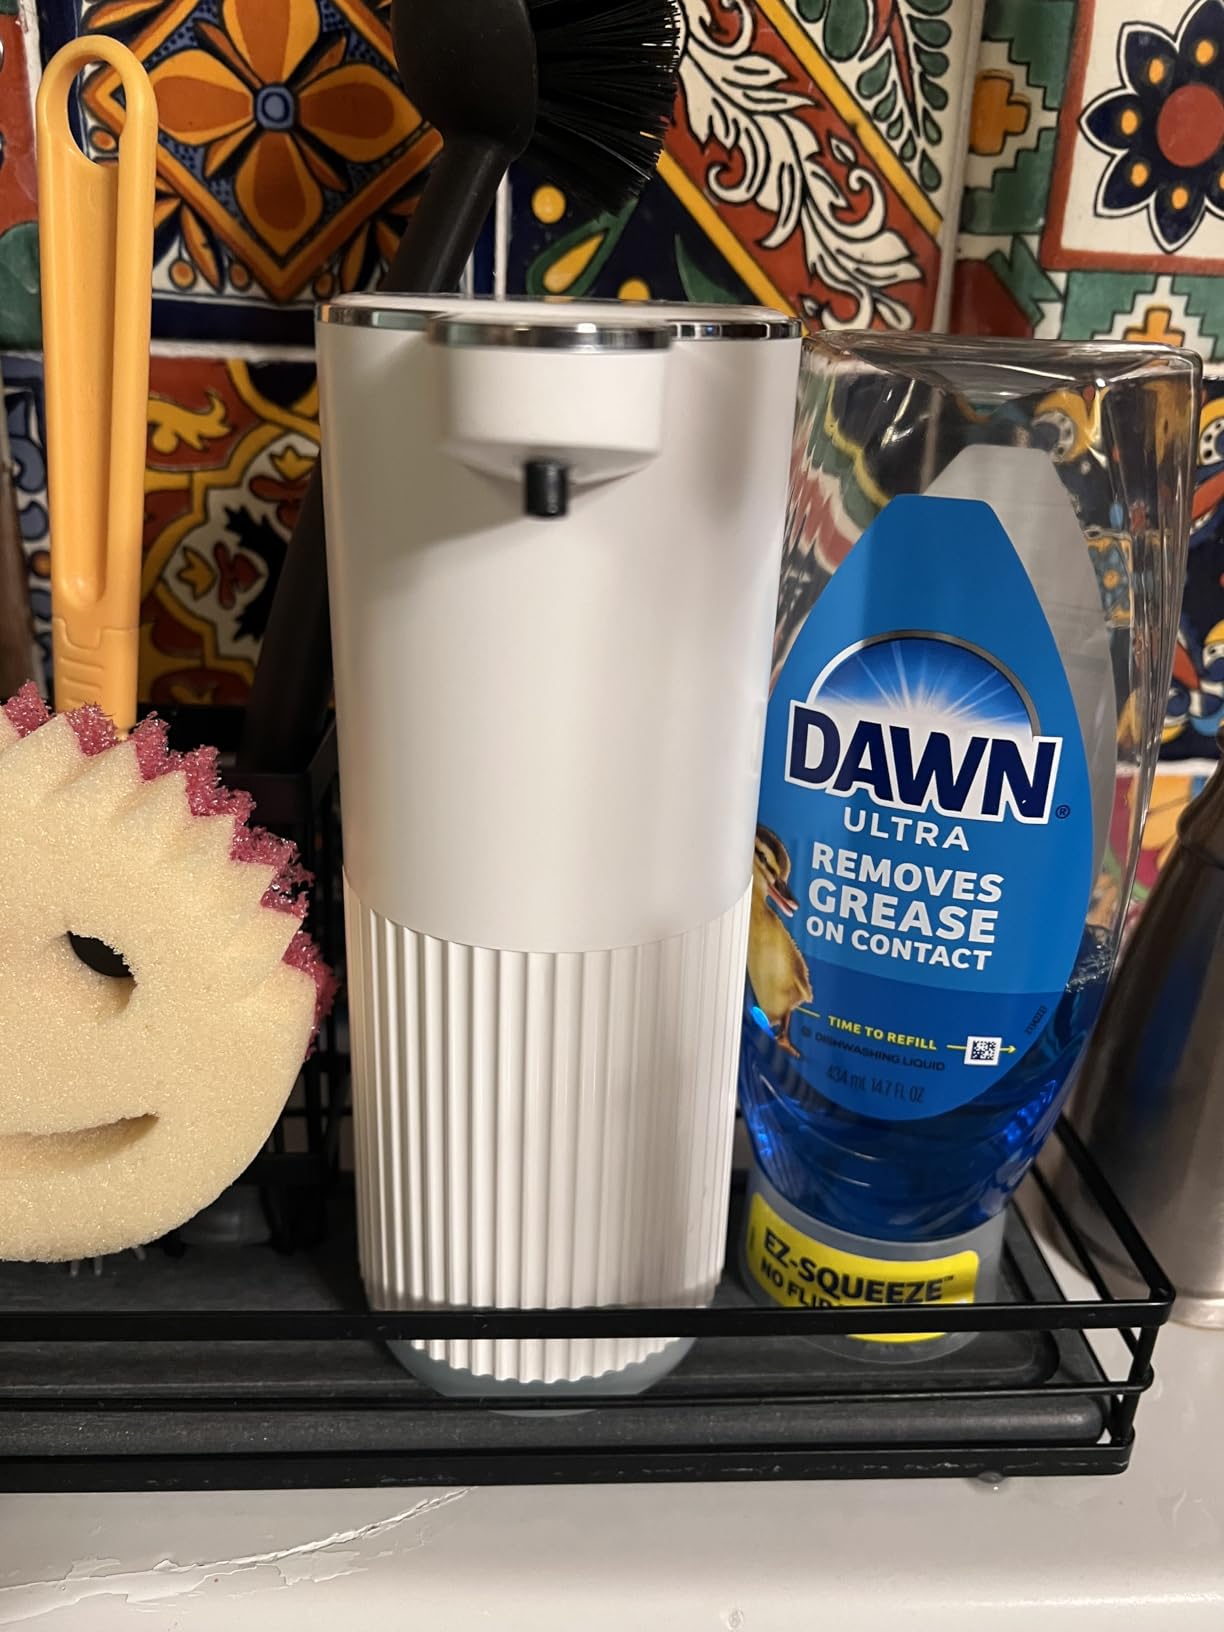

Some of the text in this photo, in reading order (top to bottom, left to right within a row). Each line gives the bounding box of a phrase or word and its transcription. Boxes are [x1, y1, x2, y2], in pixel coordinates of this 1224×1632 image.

[785, 700, 1063, 824] DAWN
[843, 806, 970, 851] ULTRA
[811, 841, 1005, 903] REMOVES
[808, 878, 998, 943] GREASE
[806, 915, 992, 971] ON CONTACT
[815, 1032, 945, 1072] DISHWASHING LIQUID
[827, 1015, 937, 1051] TIME TO REFILL
[761, 1256, 784, 1288] NO
